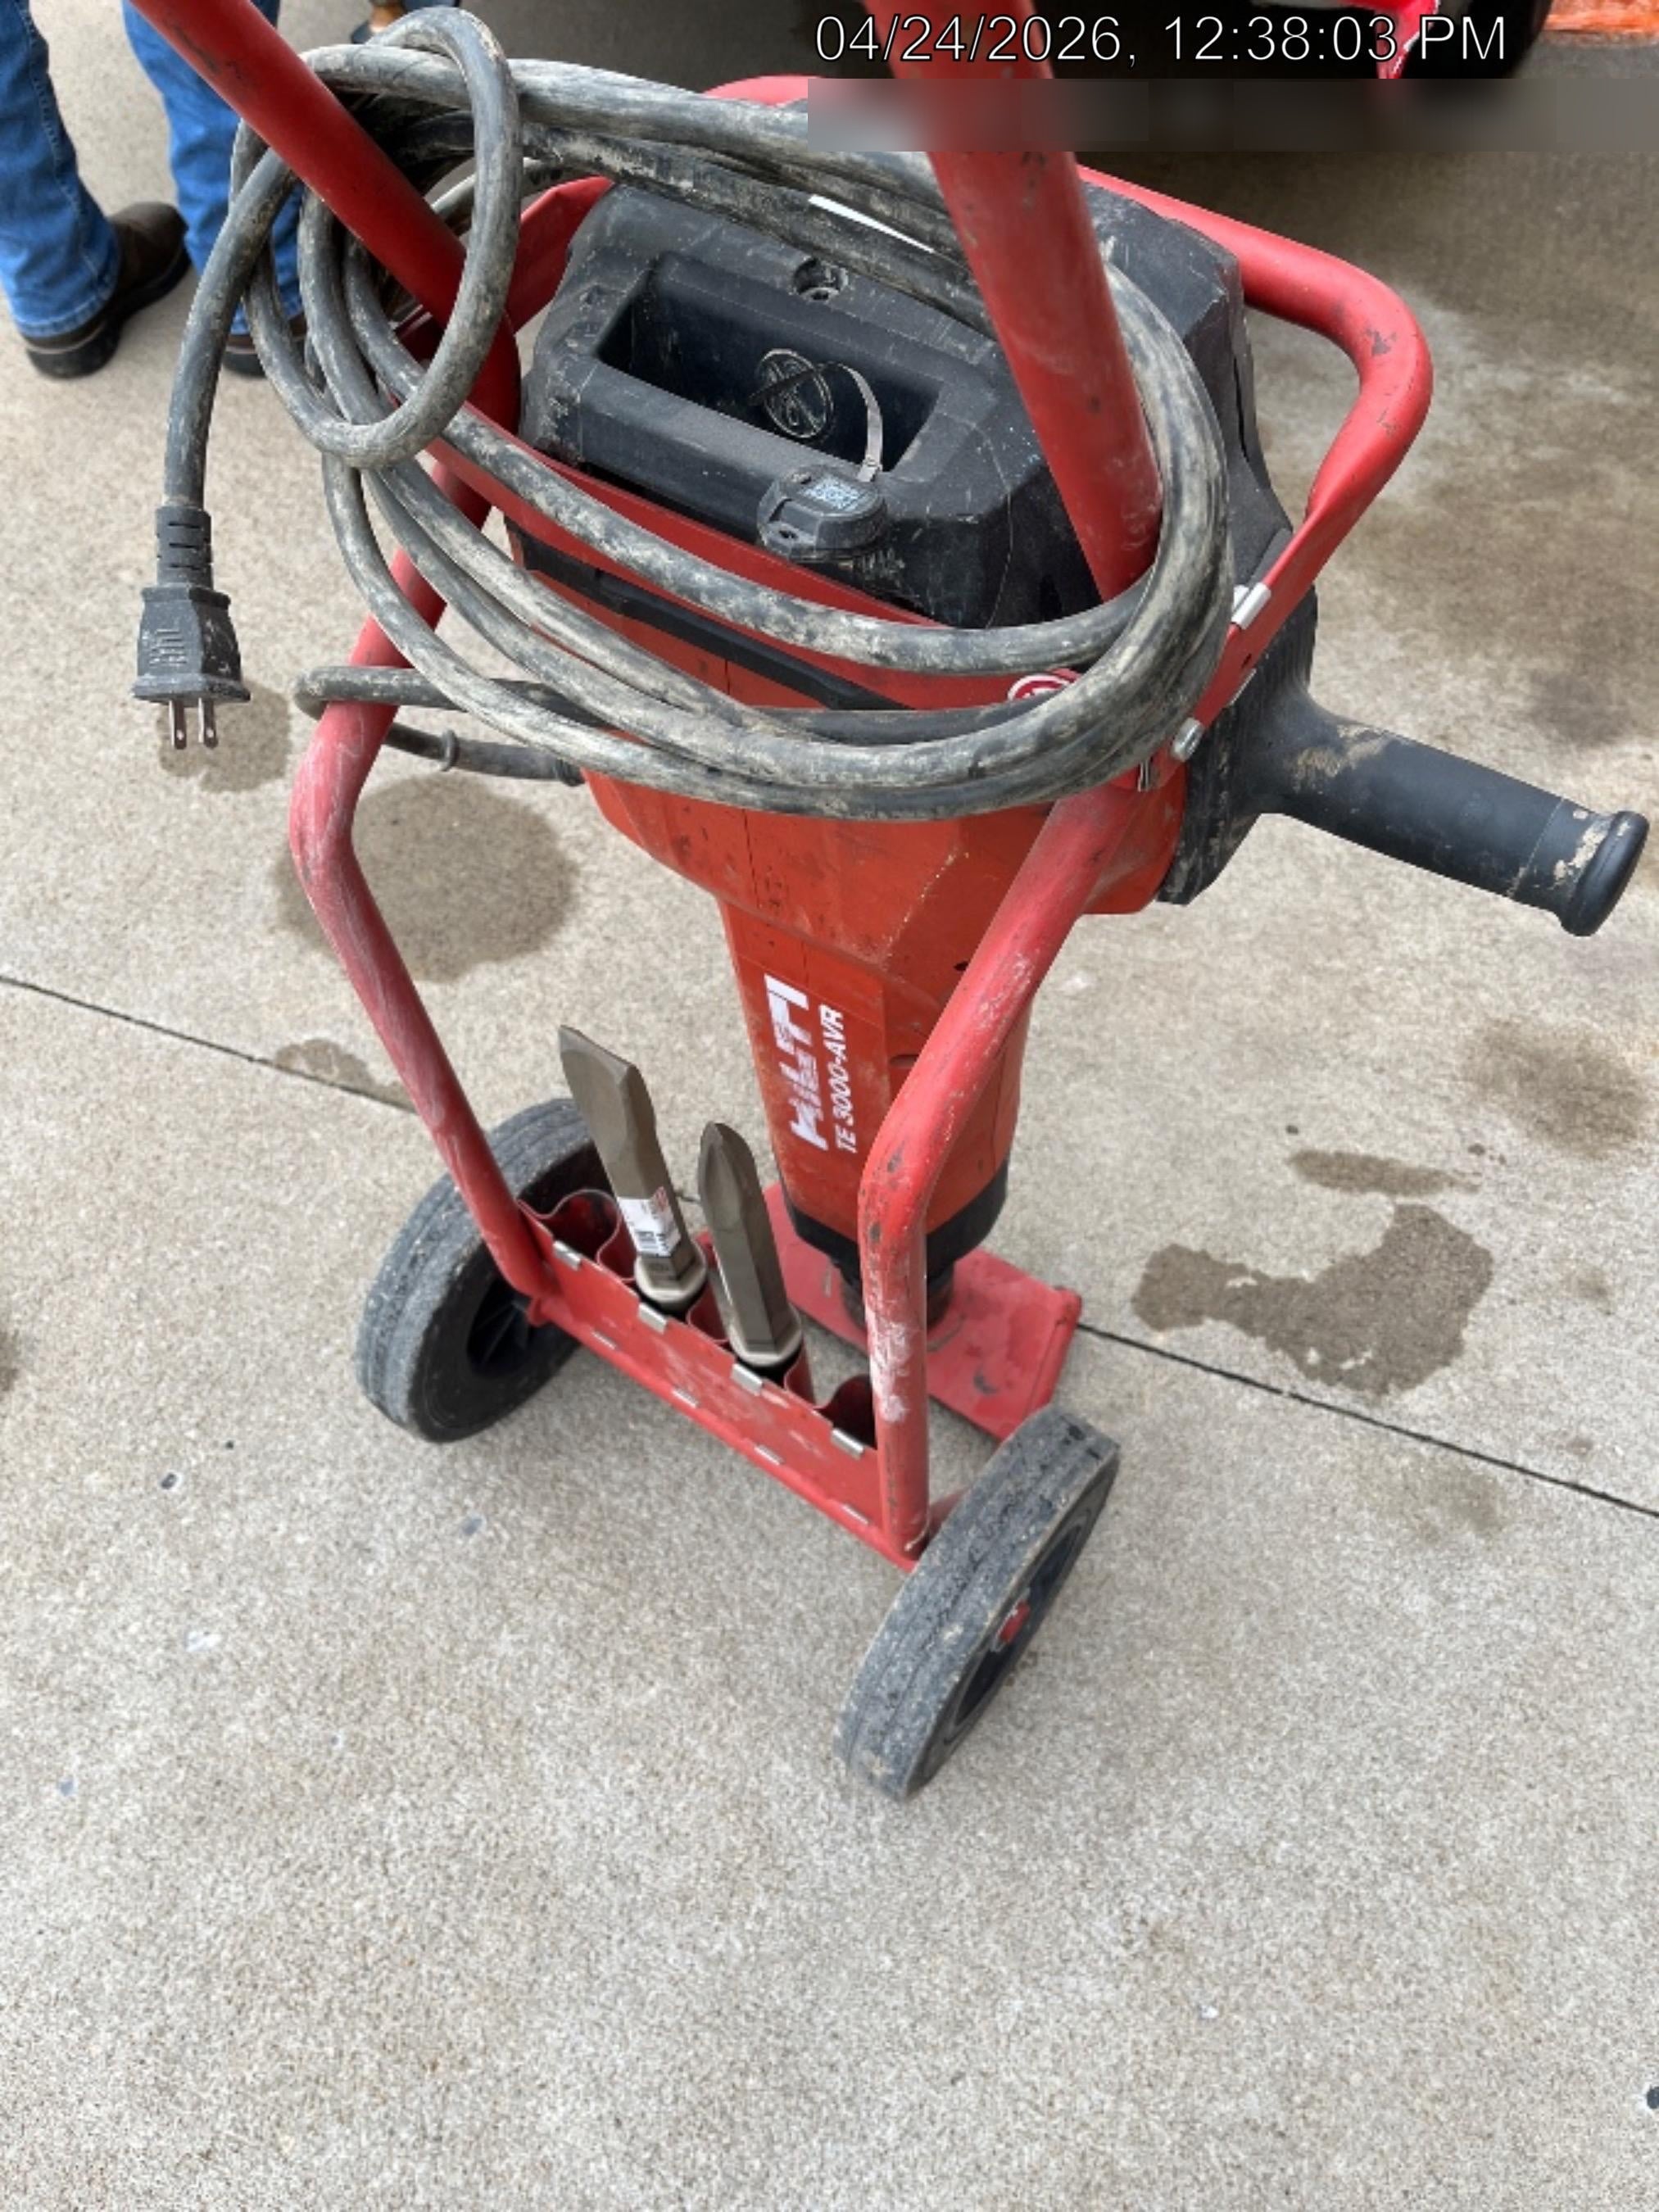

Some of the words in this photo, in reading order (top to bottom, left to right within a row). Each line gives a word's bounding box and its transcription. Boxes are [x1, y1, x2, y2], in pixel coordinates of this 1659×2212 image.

[764, 972, 828, 1151] HILTI
[819, 1004, 854, 1126] 3000-AVR
[835, 1125, 858, 1154] TE
